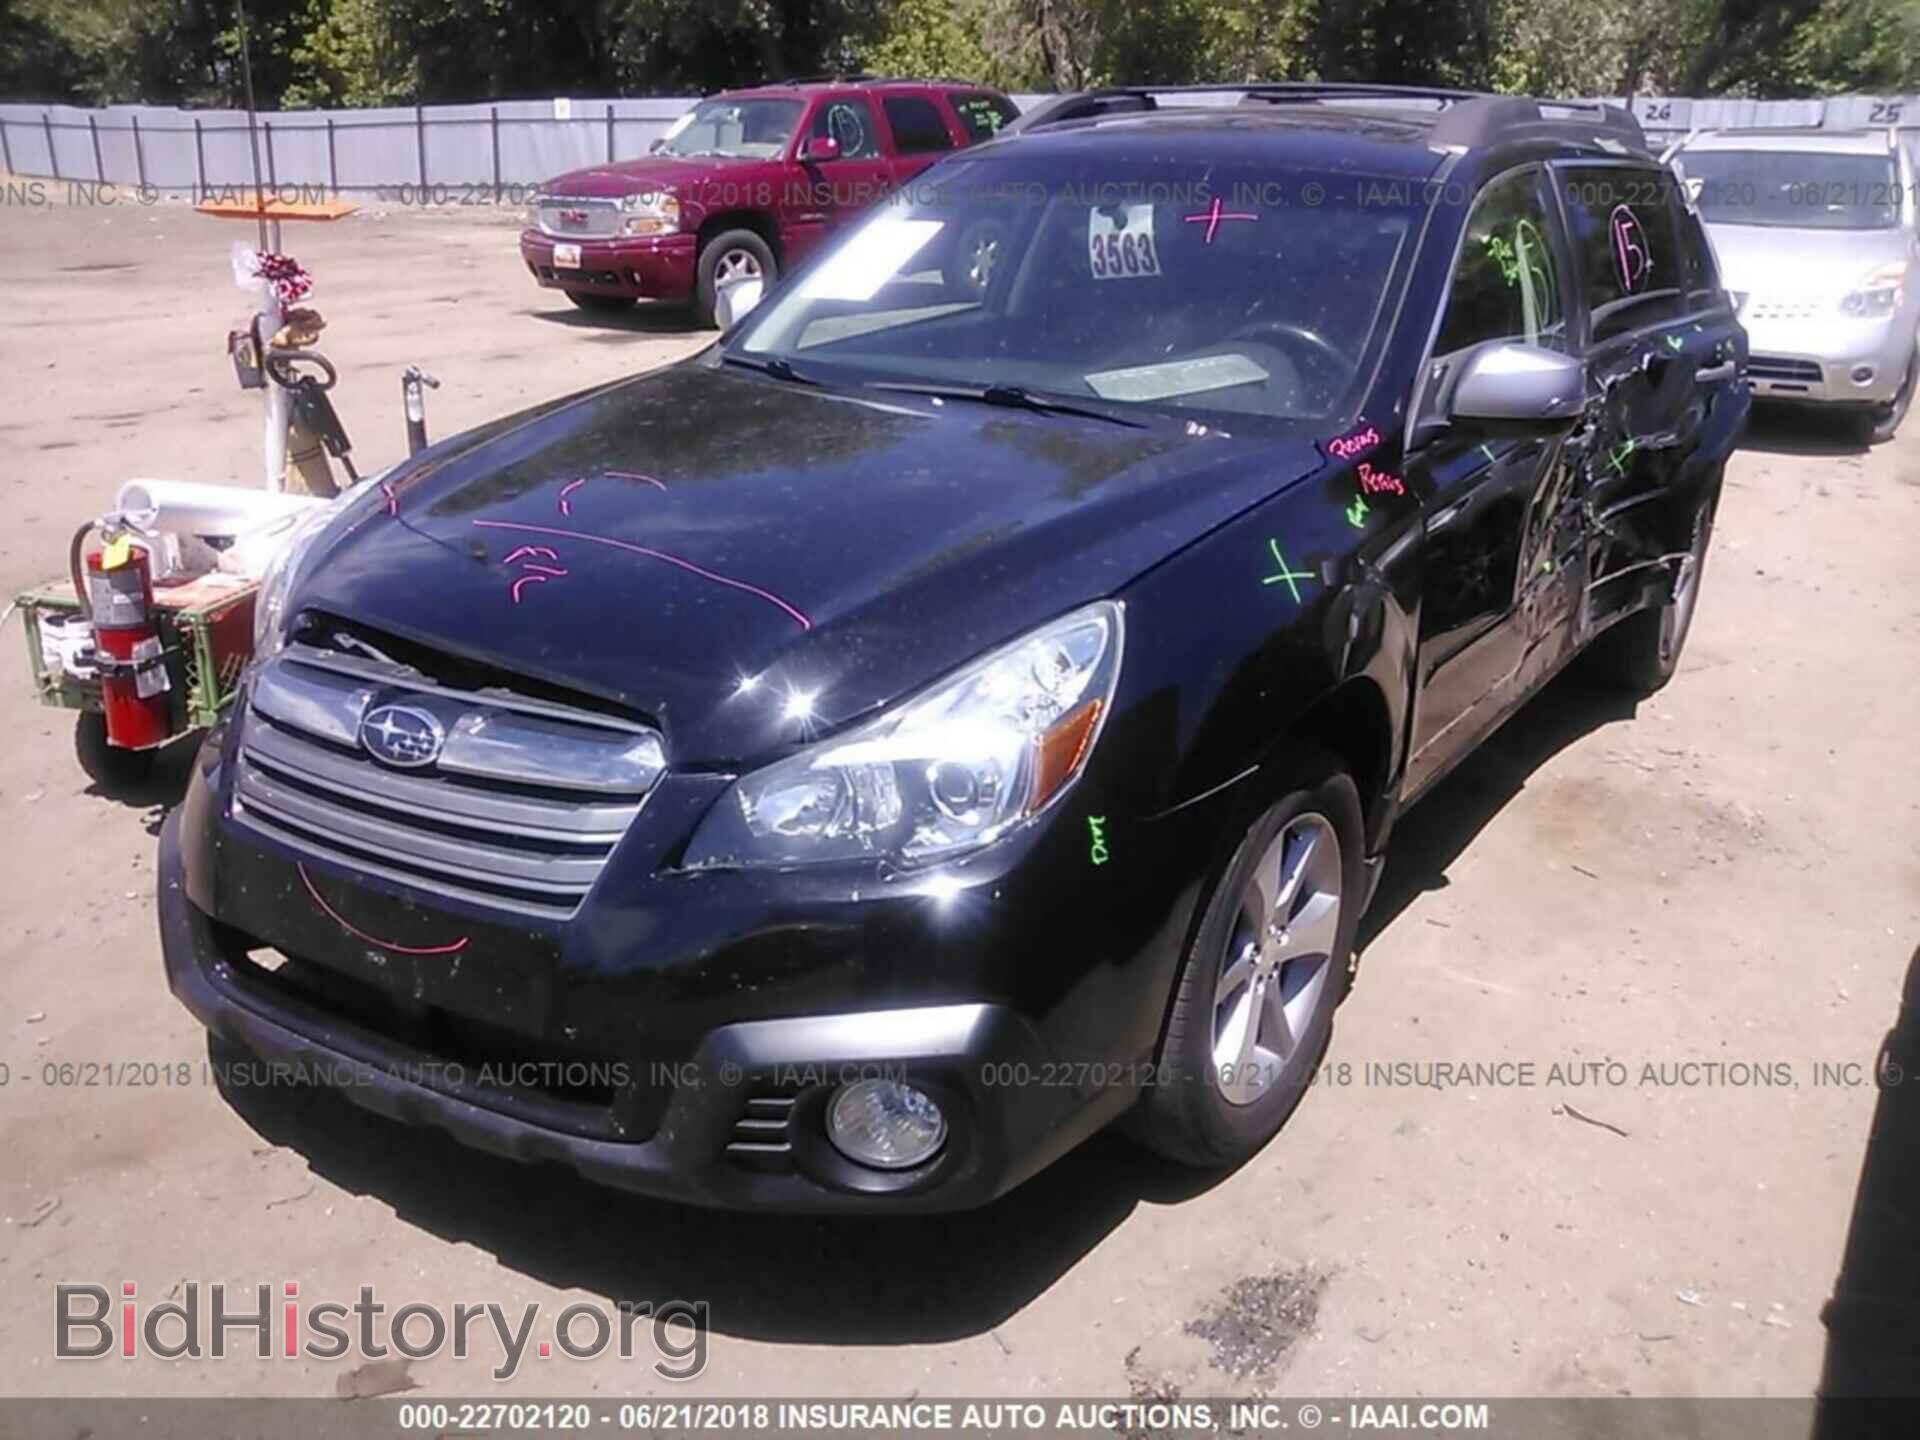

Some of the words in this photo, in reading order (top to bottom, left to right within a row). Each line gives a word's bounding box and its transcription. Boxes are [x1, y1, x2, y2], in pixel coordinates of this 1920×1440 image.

[1645, 103, 1671, 121] 26
[1868, 103, 1904, 123] 25
[1092, 233, 1156, 277] 3563
